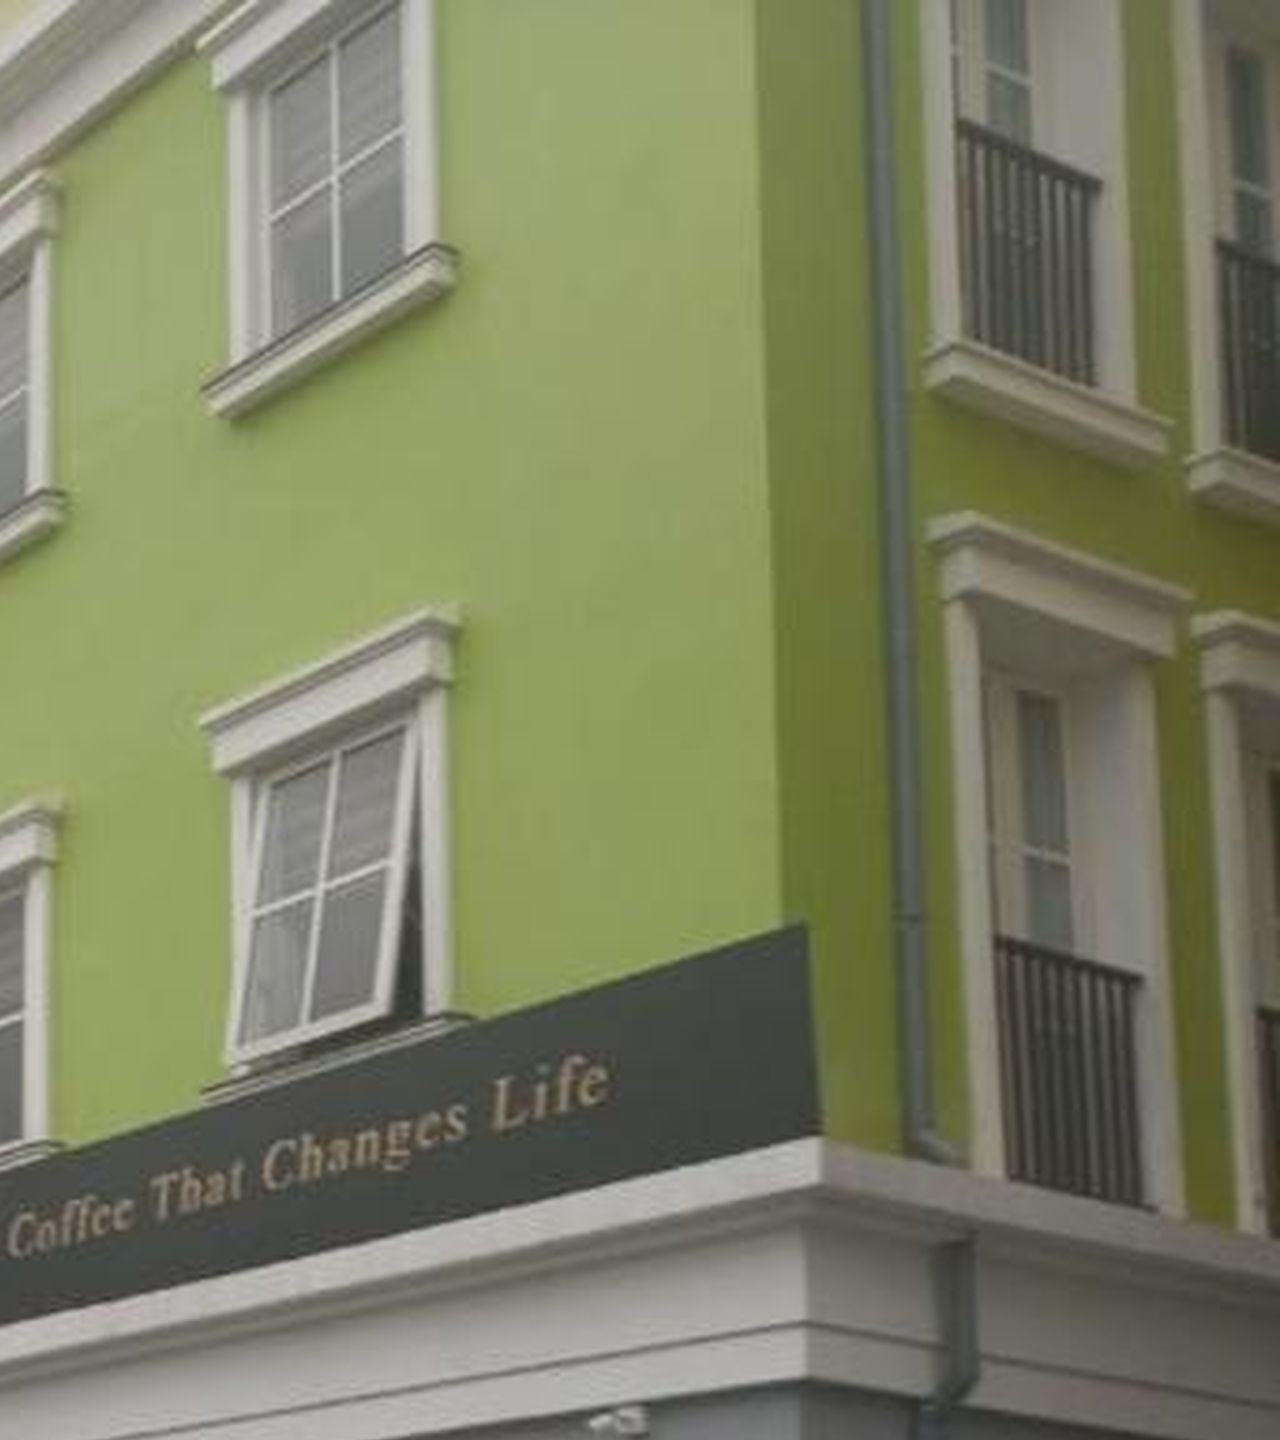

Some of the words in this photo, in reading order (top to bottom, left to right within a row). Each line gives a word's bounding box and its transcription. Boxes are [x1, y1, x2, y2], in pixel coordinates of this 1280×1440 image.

[6, 1194, 137, 1258] Coffee
[149, 1152, 246, 1221] That
[260, 1101, 469, 1191] Changes
[490, 1053, 609, 1132] Life
